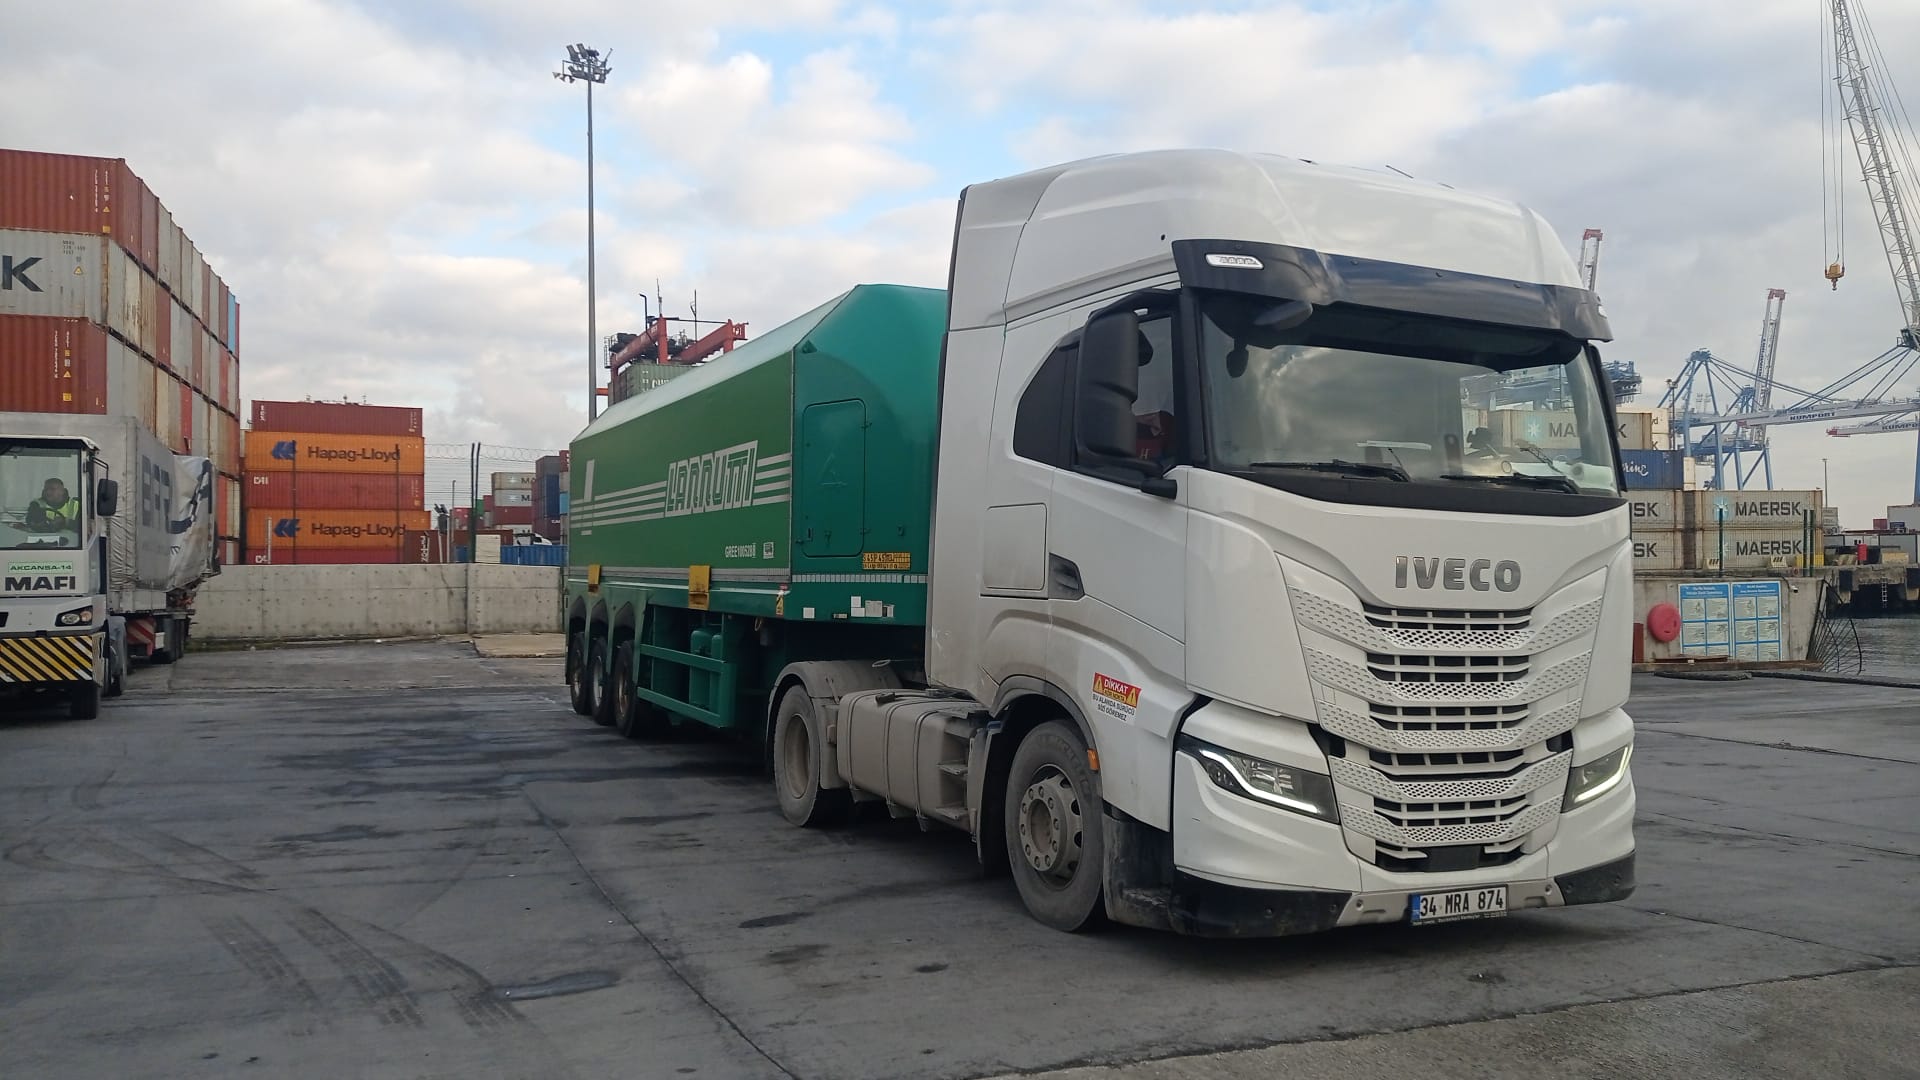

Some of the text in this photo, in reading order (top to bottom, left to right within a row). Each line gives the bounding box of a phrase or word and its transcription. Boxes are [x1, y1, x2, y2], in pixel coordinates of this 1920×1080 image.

[308, 445, 400, 462] Hapag-Lloyd
[1735, 501, 1802, 516] MAERSK
[311, 523, 406, 538] Hapag-Lloyd
[1736, 540, 1803, 556] MAERSK
[1395, 555, 1521, 592] IVECO
[5, 576, 76, 591] MAFI
[1420, 897, 1437, 916] 34
[1445, 893, 1470, 914] MRA
[1478, 890, 1504, 909] 874
